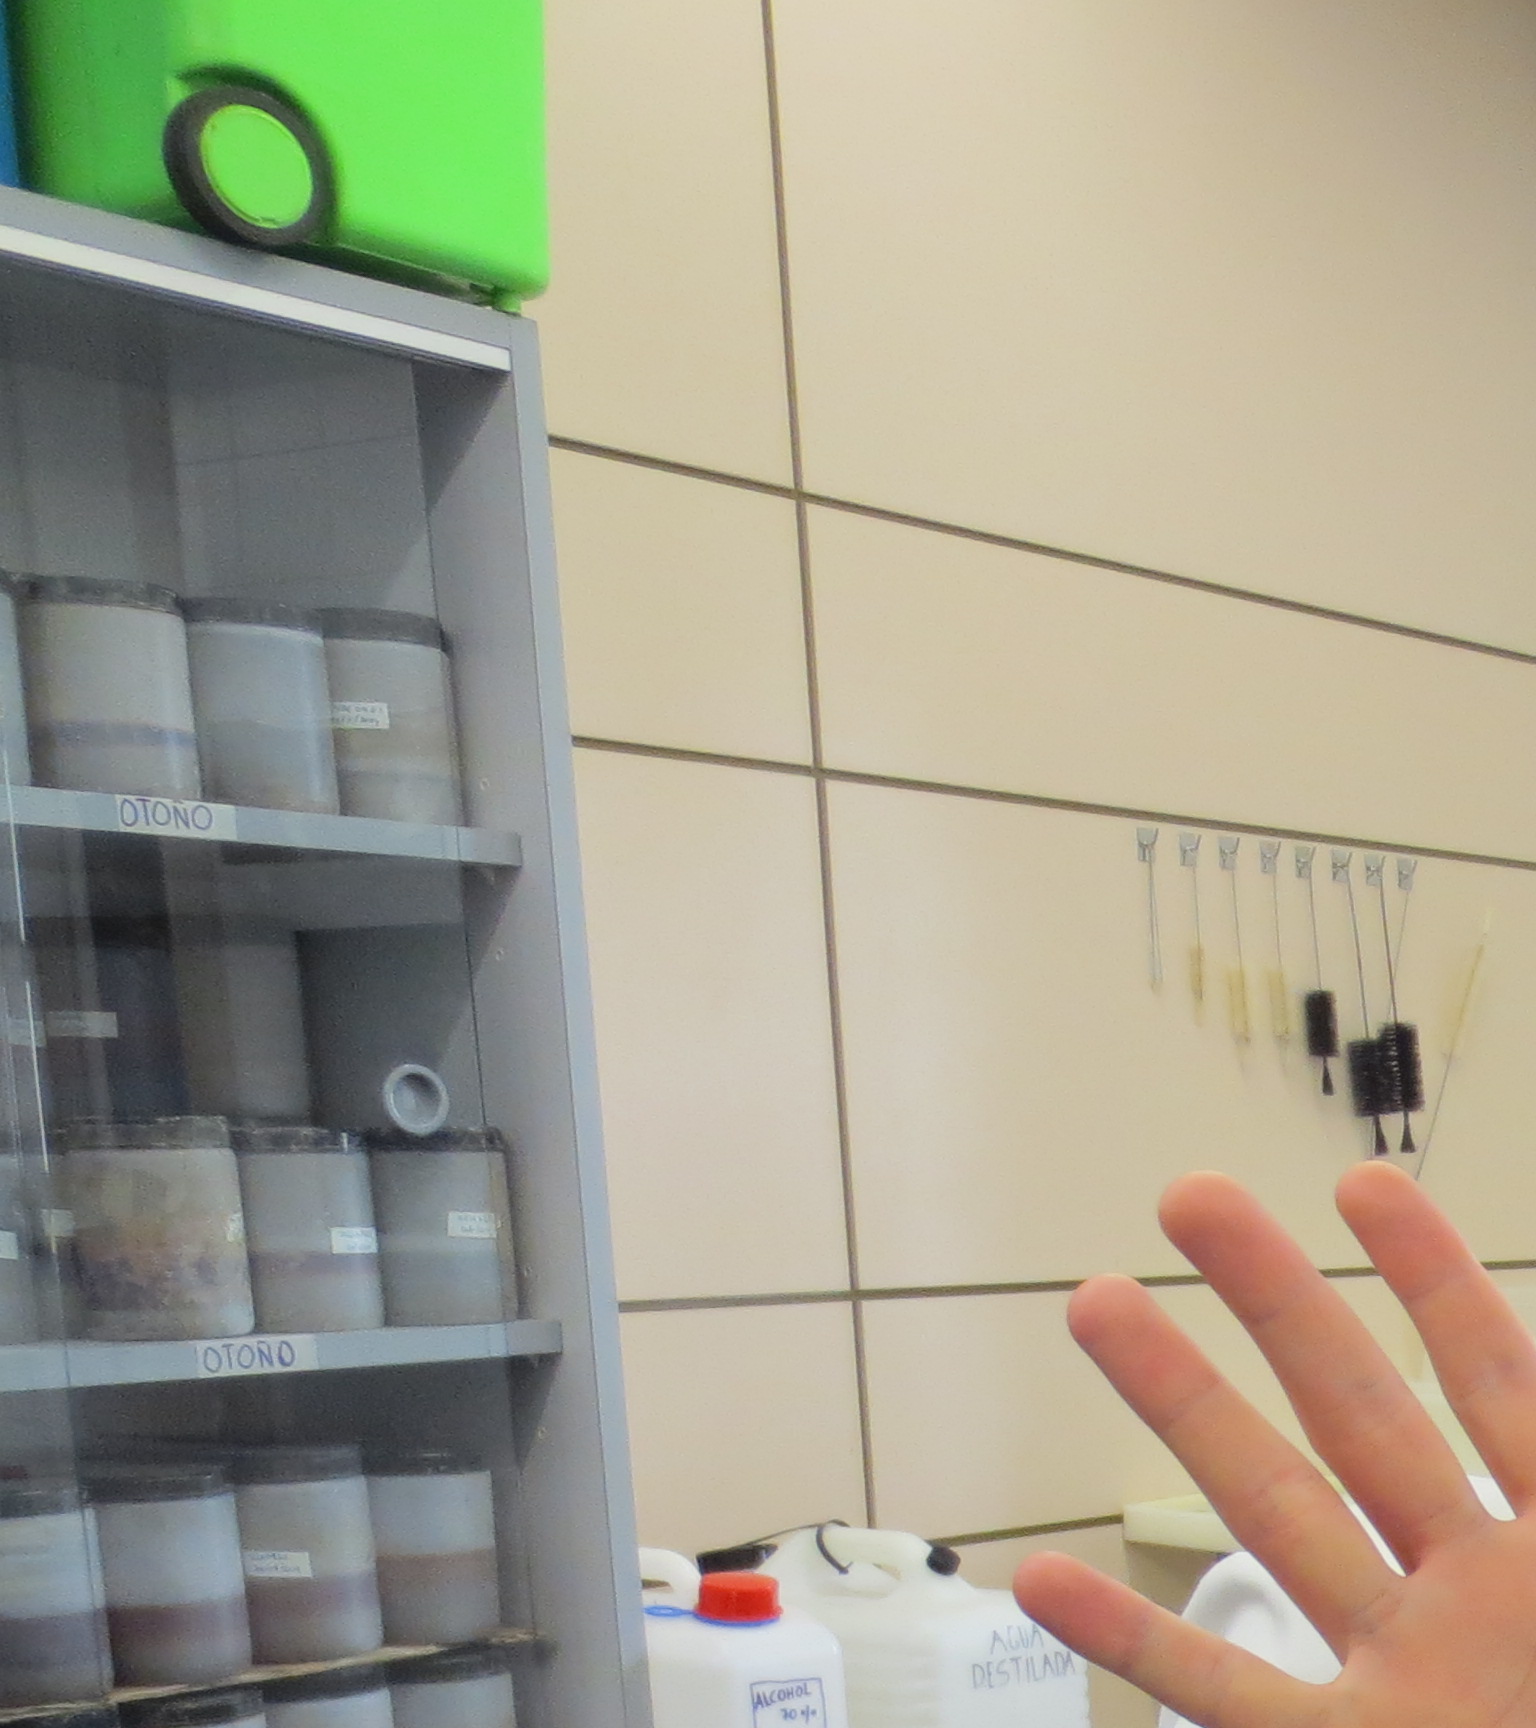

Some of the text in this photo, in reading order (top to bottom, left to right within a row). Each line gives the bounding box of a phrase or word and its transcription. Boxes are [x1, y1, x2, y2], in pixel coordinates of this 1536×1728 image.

[120, 798, 213, 830] OTOÑO
[990, 1624, 1044, 1655] AGUA
[972, 1651, 1076, 1689] DESTILADA
[753, 1682, 812, 1711] ALCOHOL
